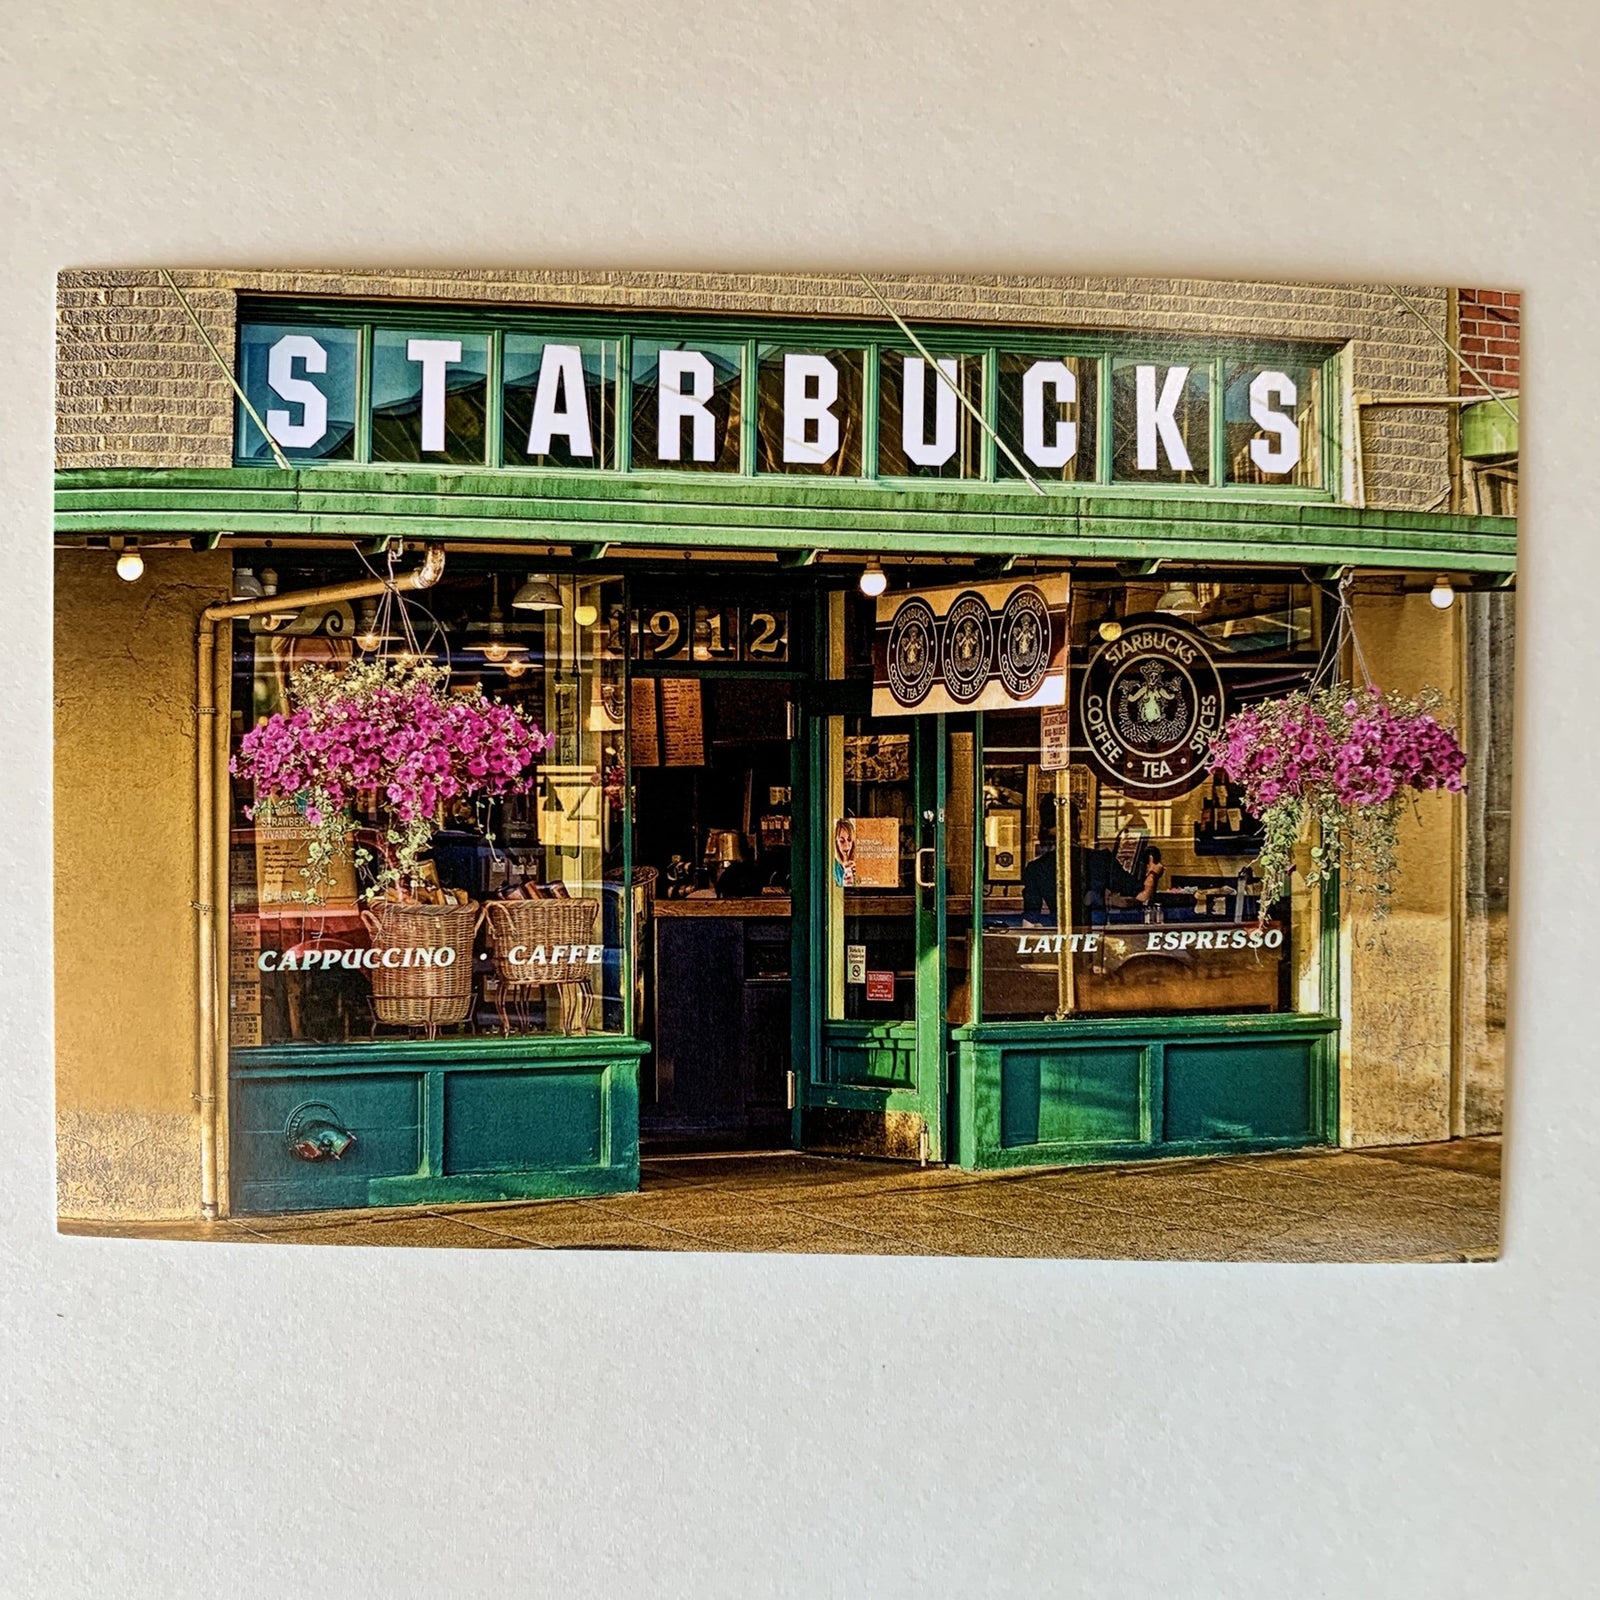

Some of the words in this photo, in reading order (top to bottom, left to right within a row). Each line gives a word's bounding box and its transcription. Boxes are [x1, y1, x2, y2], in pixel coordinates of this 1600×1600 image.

[266, 333, 1301, 476] STARBUCKS
[897, 608, 930, 631] STARBUCKS
[951, 601, 986, 625] STARBUCKS
[1008, 595, 1044, 620] STARBUCKS
[1104, 632, 1198, 667] STARBUCKS
[890, 663, 906, 697] COFFEE
[906, 688, 918, 699] TEA
[918, 660, 935, 694] SPICES
[944, 658, 960, 693] COFFEE
[961, 683, 973, 696] TEA
[973, 656, 990, 690] SPICES
[1001, 653, 1018, 689] COFFEE
[1018, 680, 1031, 692] TEA
[1031, 651, 1049, 685] SPICES
[1087, 695, 1123, 764] COFFEE
[1141, 760, 1173, 778] TEA
[1189, 694, 1217, 755] SPICES
[258, 946, 456, 972] CAPPUCCINO
[508, 944, 604, 966] CAFFE
[1017, 933, 1099, 955] LATTE
[1146, 928, 1284, 952] ESPRESSO
